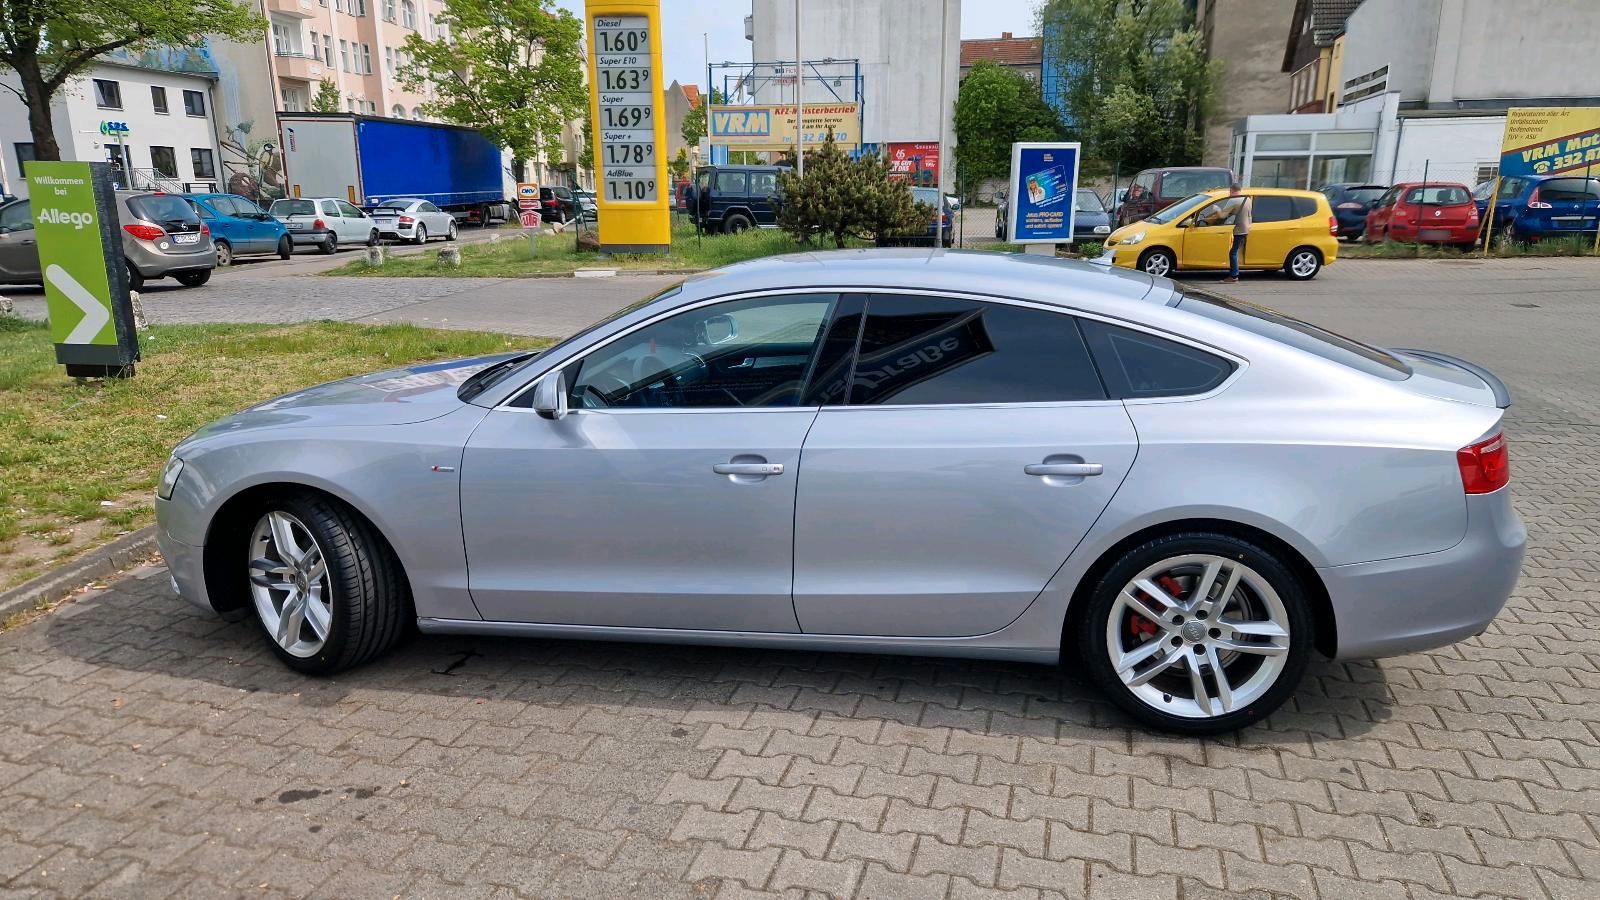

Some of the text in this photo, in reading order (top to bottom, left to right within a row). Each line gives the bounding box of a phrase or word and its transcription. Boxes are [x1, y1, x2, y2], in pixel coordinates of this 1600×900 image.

[597, 19, 622, 28] Diesel
[600, 31, 647, 52] 1.609
[600, 57, 637, 66] Super E10
[602, 70, 649, 90] 1.639
[602, 95, 624, 105] Super
[604, 107, 651, 128] 1.699
[714, 112, 769, 133] VRM
[604, 133, 626, 142] Super
[606, 144, 653, 164] 1.789
[1522, 143, 1560, 163] VRM
[1553, 152, 1583, 170] 332
[34, 175, 84, 186] Willkommen
[607, 170, 634, 178] AdBlue
[54, 186, 68, 196] bei
[609, 181, 655, 200] 1.109
[37, 207, 93, 230] Allego
